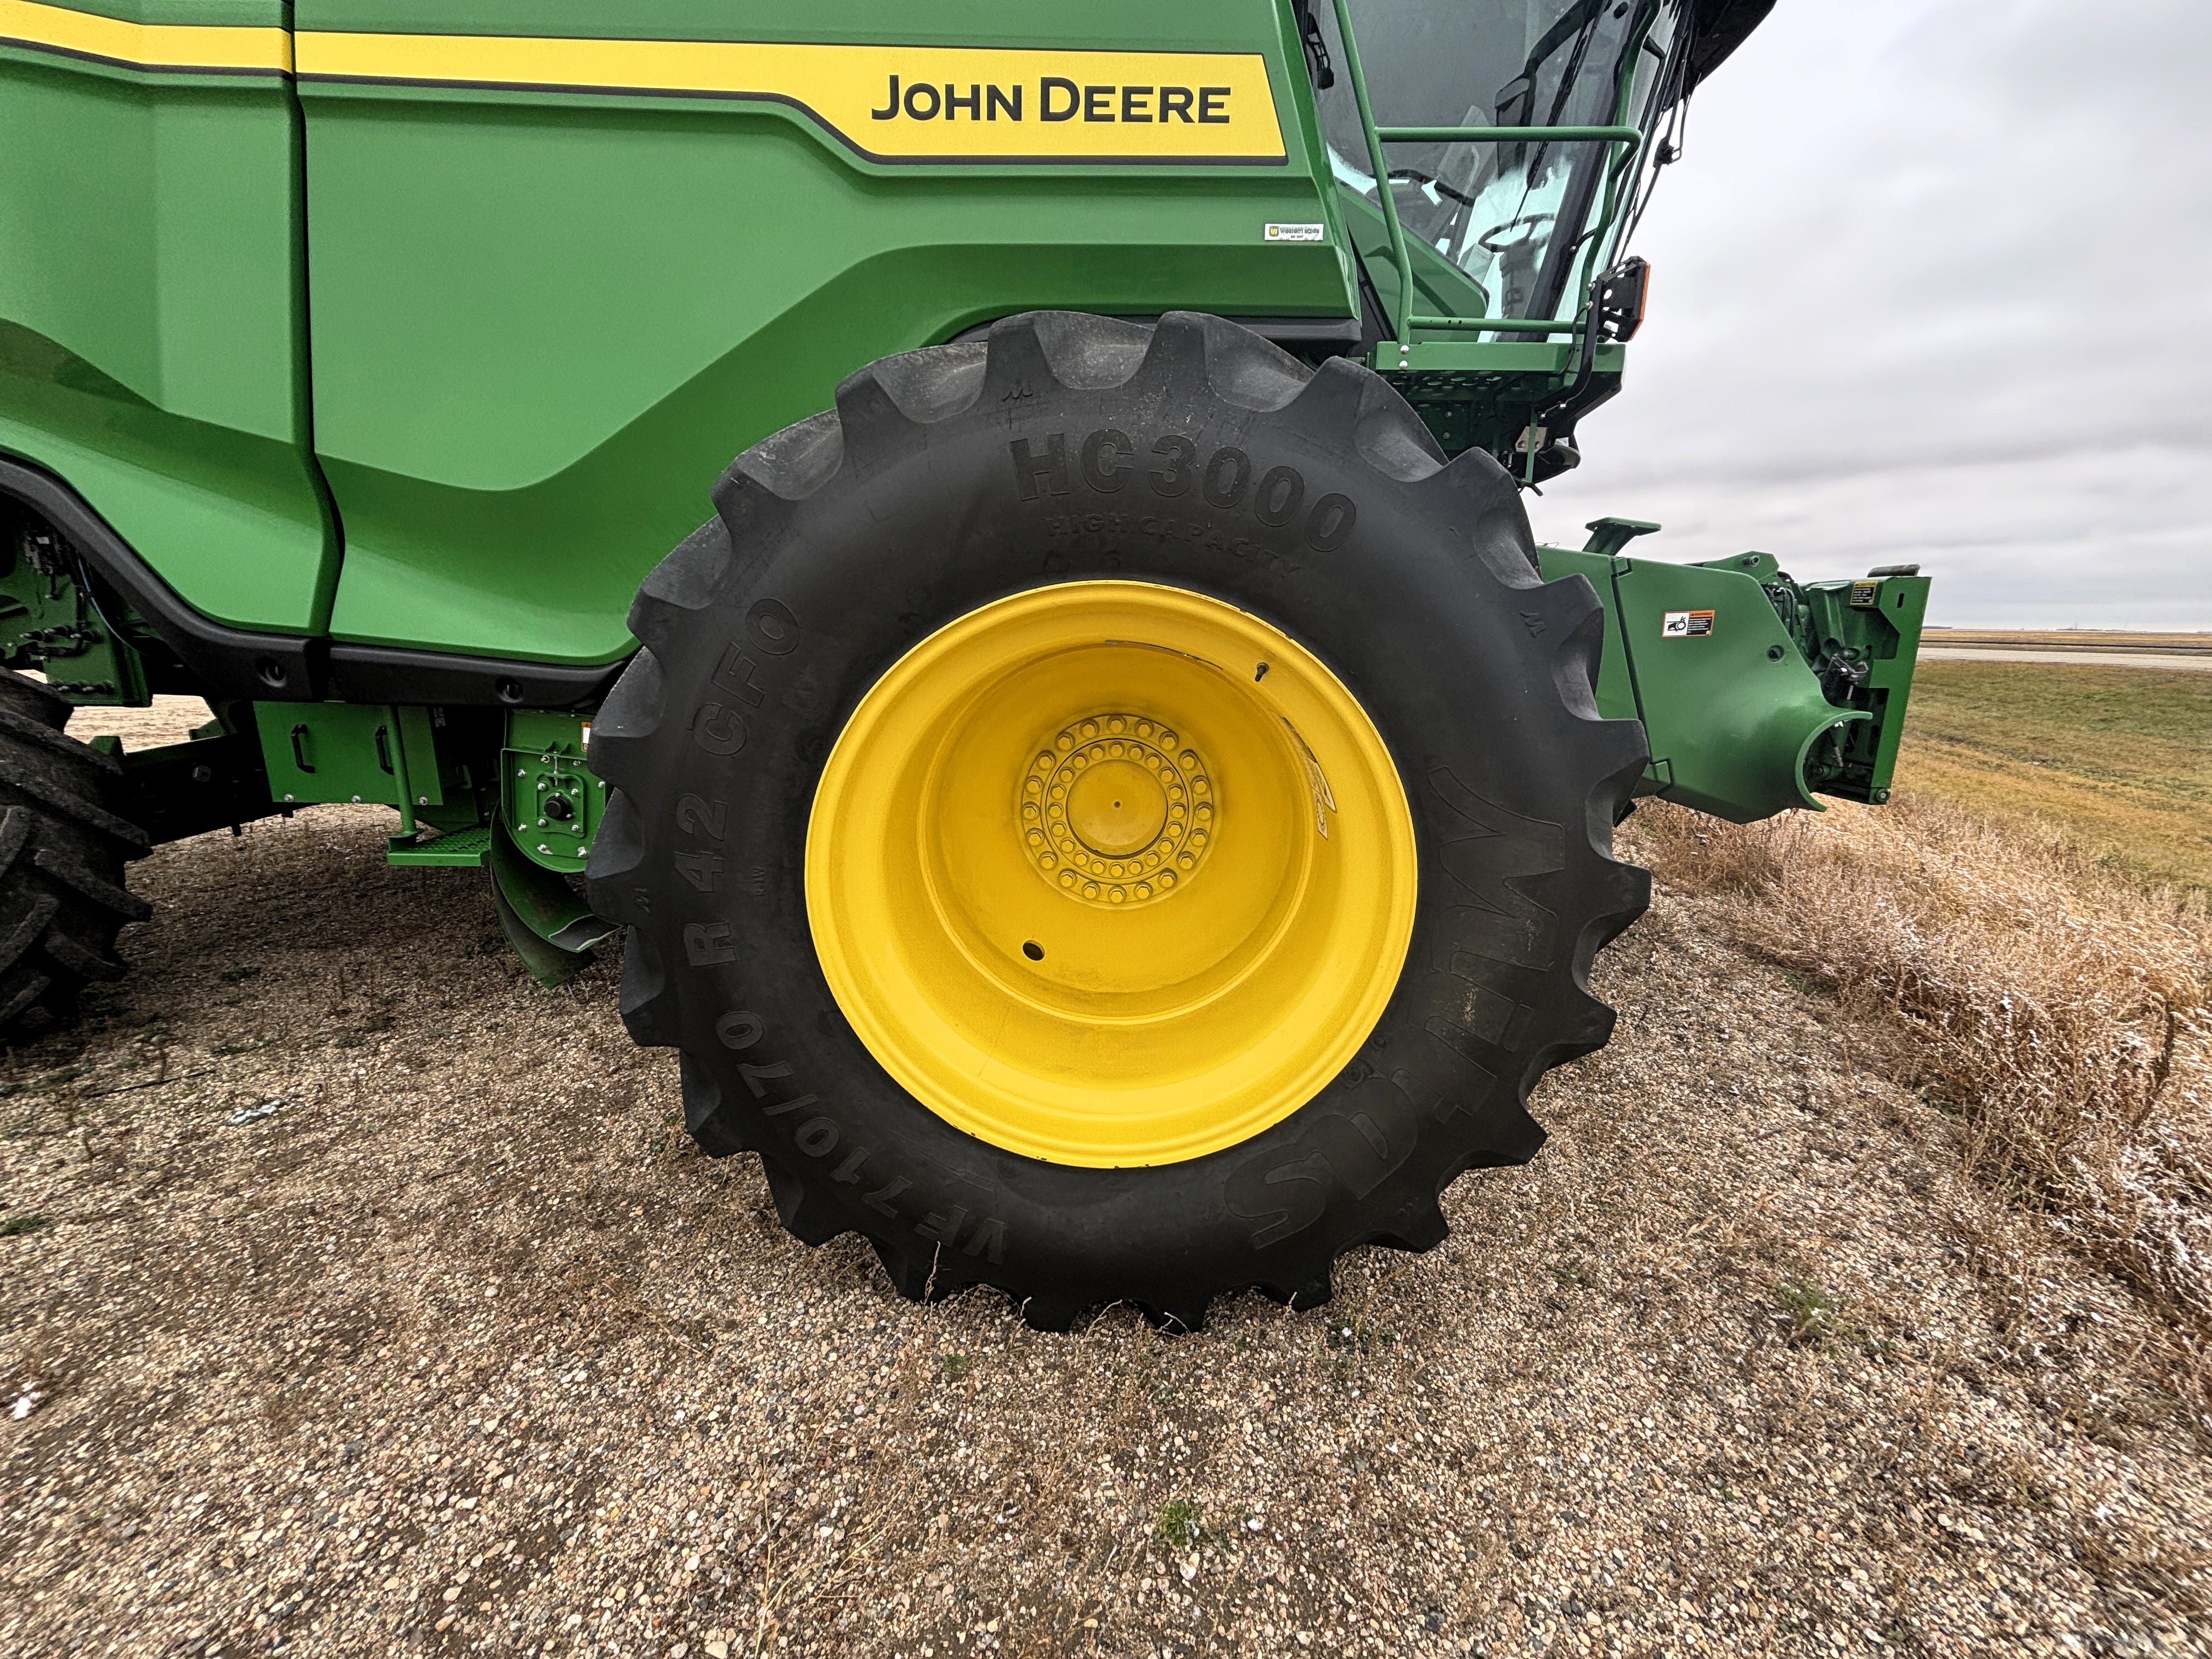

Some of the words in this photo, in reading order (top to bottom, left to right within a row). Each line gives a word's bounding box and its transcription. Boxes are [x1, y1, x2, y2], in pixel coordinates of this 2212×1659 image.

[871, 75, 1022, 121] JOHN
[1040, 76, 1231, 124] DEERE
[1045, 514, 1128, 537] HIGH
[1138, 516, 1302, 578] CAPACITY
[692, 597, 800, 756] CFO
[673, 793, 728, 893] 42
[683, 921, 738, 967] R
[715, 1011, 913, 1219] 710/70
[914, 1204, 1007, 1265] VF
